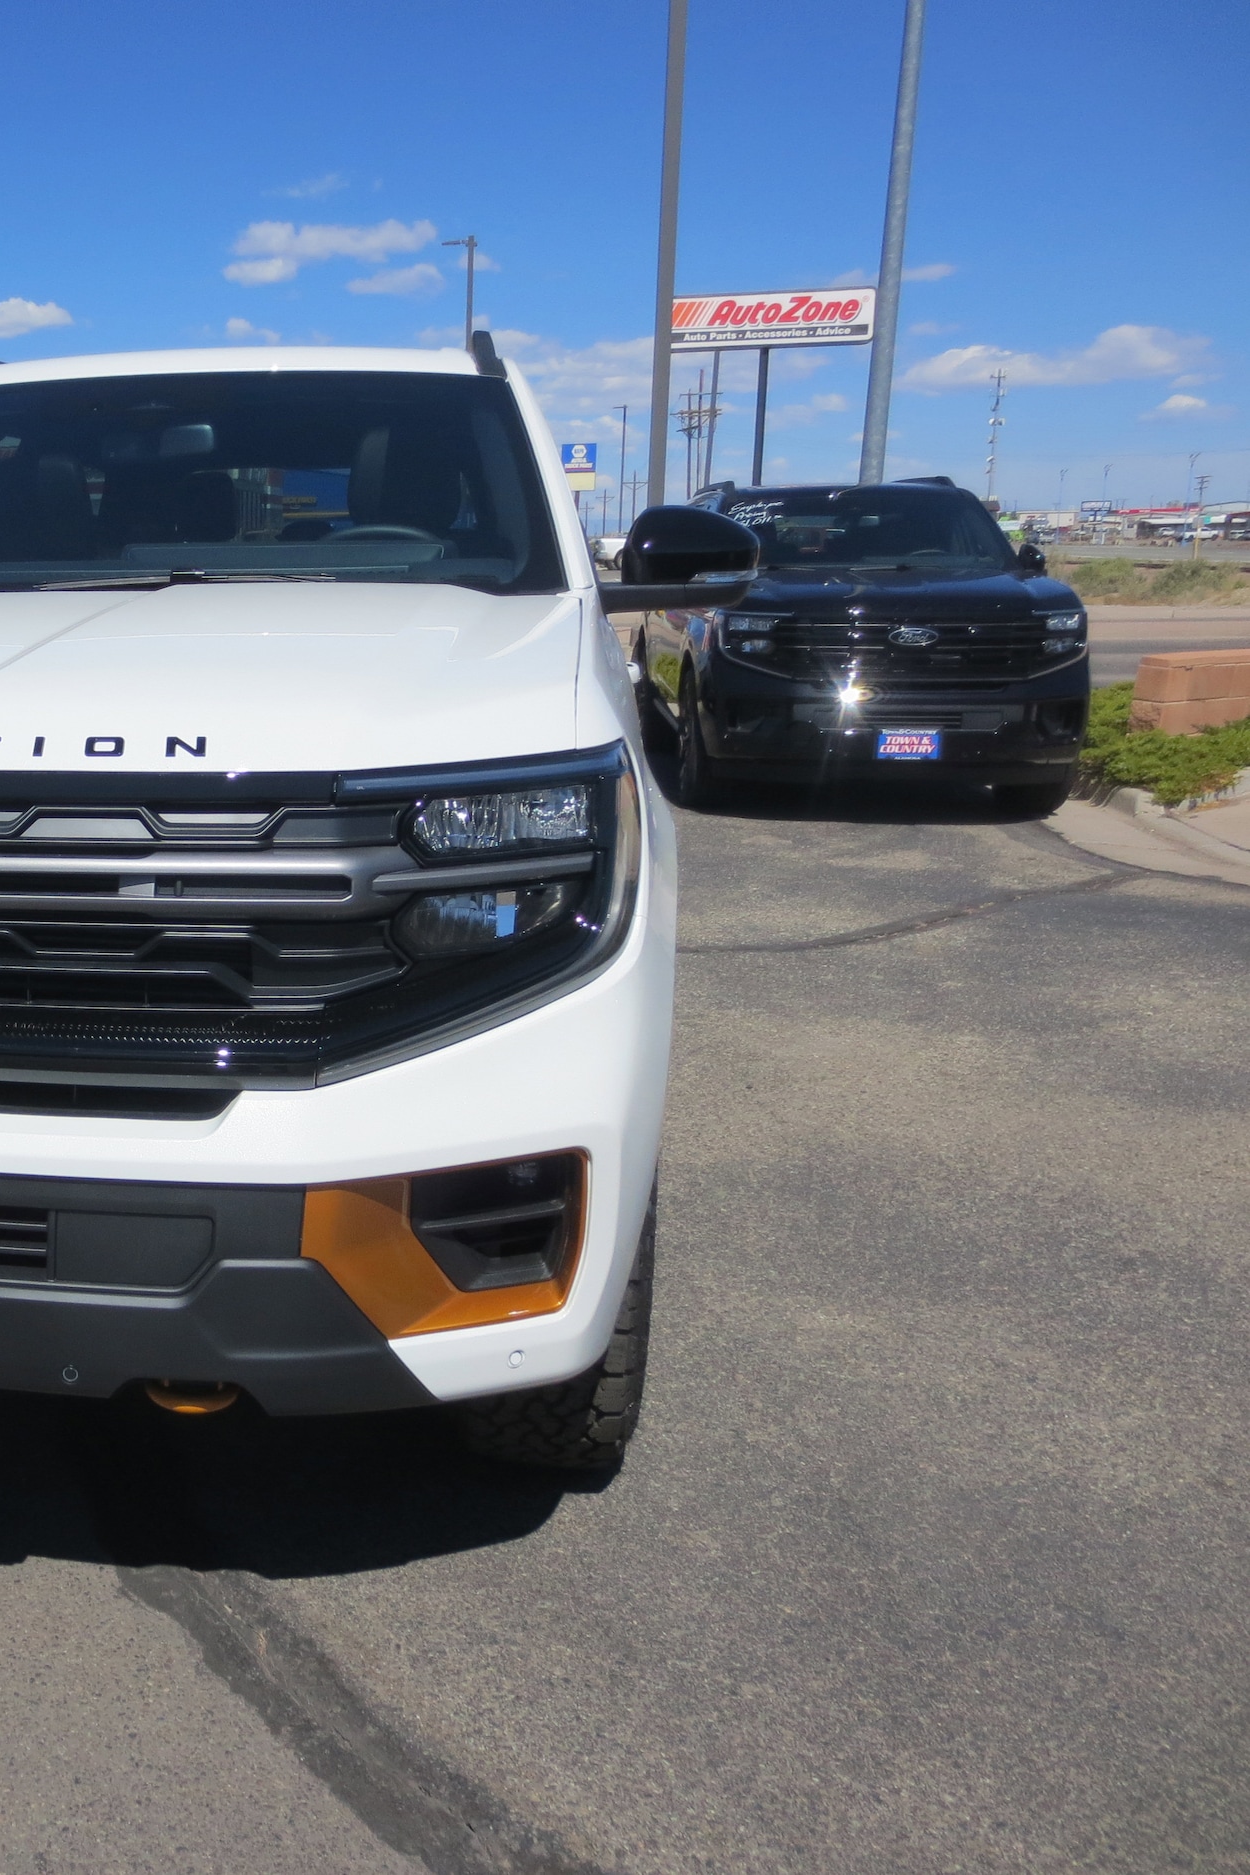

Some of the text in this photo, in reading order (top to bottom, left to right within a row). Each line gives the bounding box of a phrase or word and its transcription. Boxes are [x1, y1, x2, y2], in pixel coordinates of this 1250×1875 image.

[706, 295, 862, 328] AutoZone
[683, 326, 851, 342] Auto Parts Accessories Advice
[898, 630, 929, 643] Ford
[885, 736, 932, 745] TOWN &
[879, 744, 936, 754] COUNTRY
